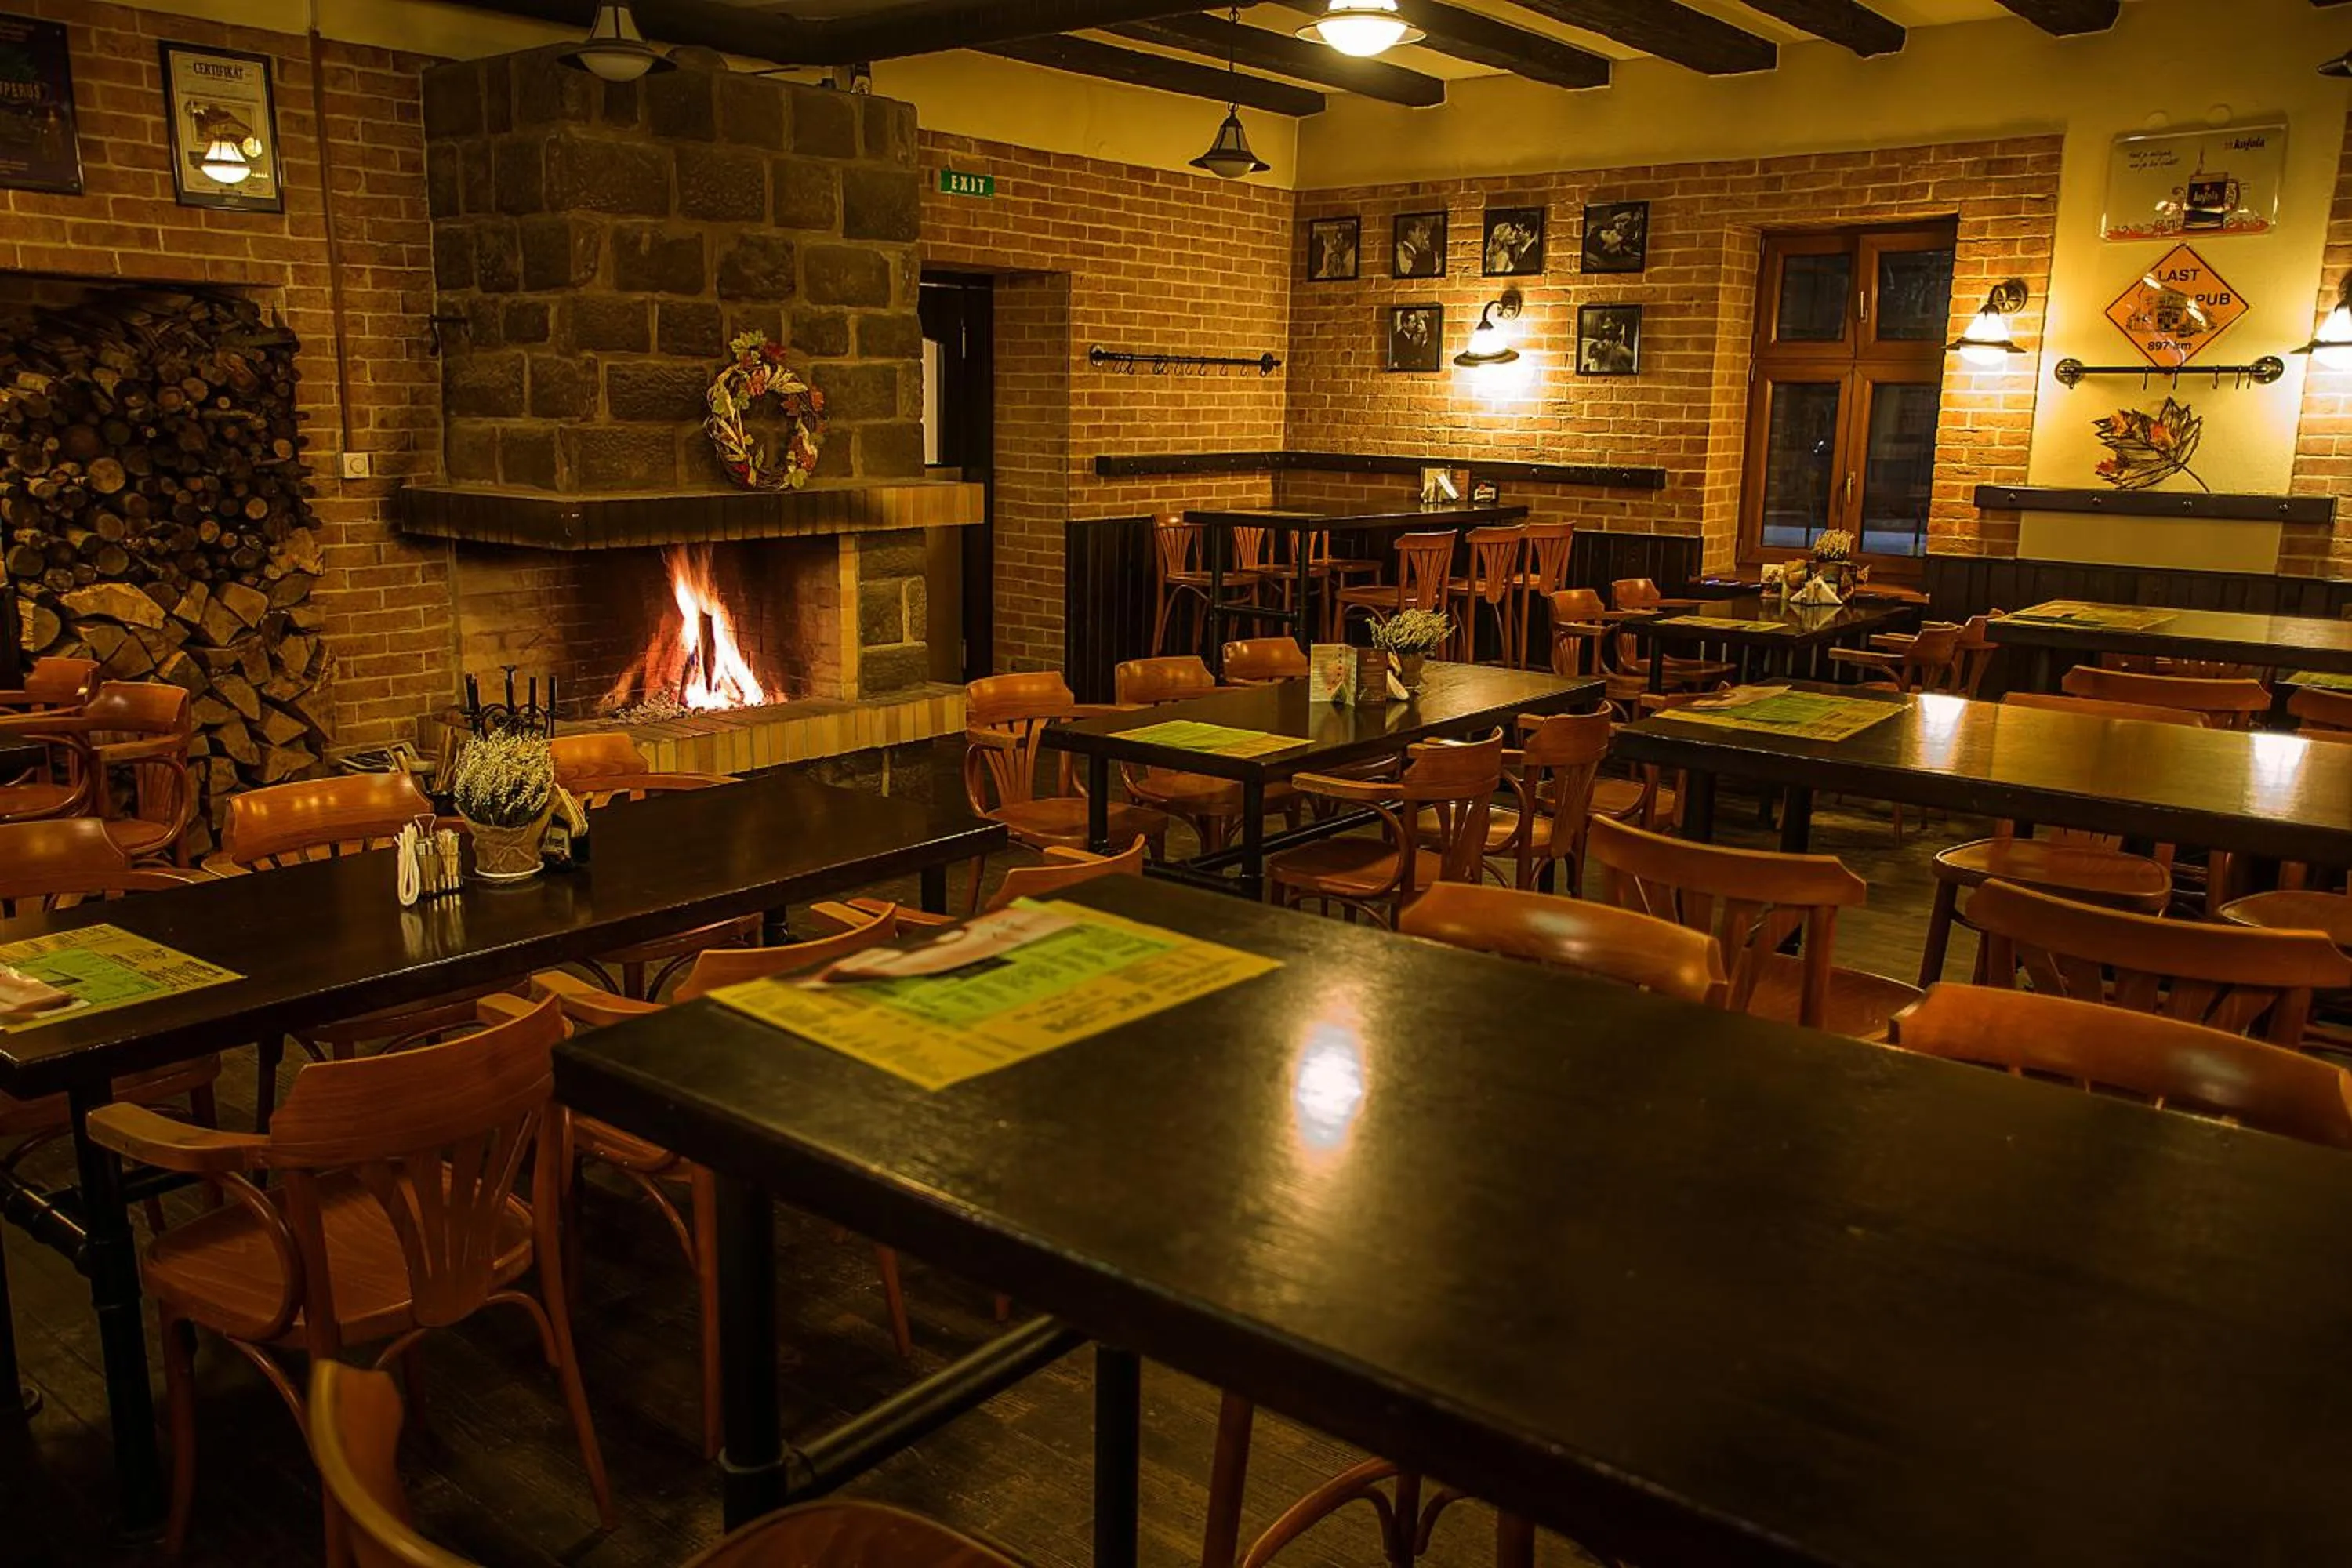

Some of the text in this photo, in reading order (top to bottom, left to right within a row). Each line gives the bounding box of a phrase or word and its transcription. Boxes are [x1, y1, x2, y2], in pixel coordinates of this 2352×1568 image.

[951, 175, 985, 194] EXIT
[2158, 269, 2201, 282] LAST
[2195, 292, 2230, 306] PUB
[2147, 341, 2170, 351] 897
